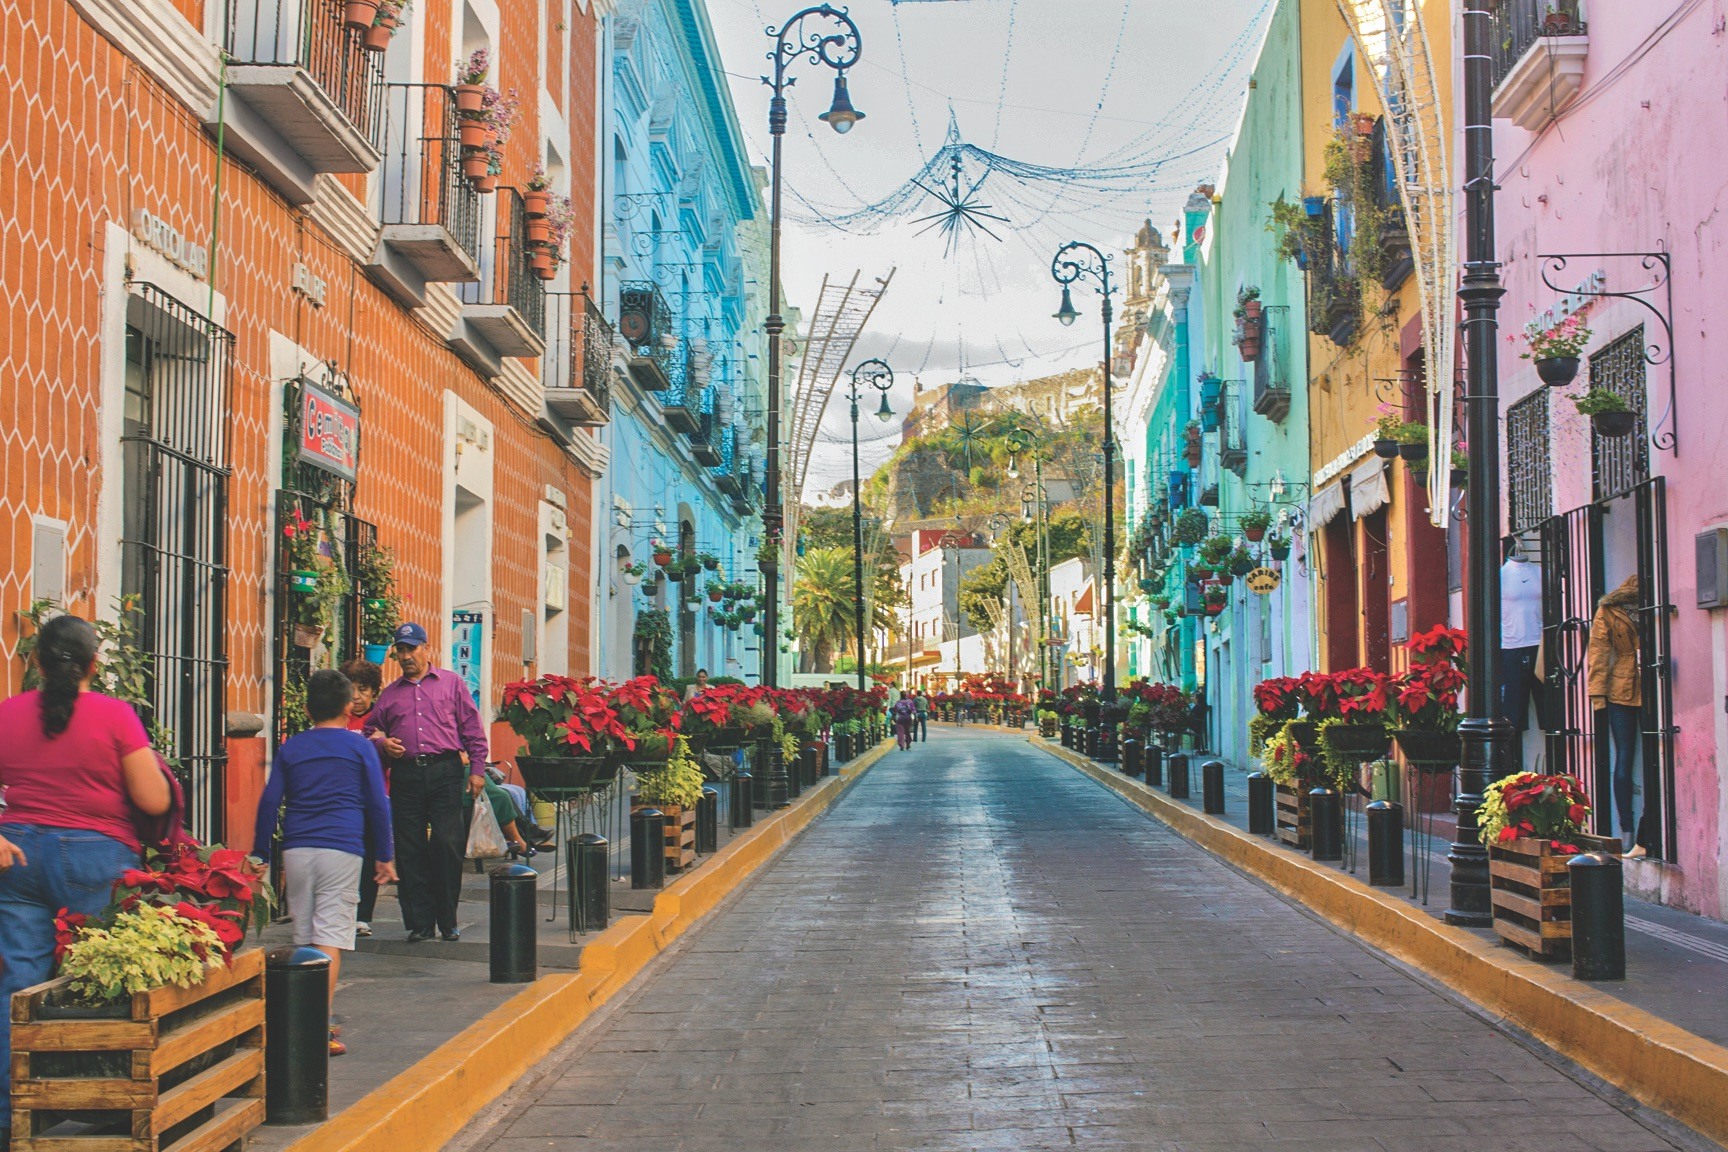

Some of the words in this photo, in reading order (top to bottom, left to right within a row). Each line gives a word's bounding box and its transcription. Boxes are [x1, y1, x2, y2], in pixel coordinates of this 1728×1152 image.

[138, 207, 209, 278] ORTOLAB
[1247, 569, 1280, 583] CARIBE
[459, 628, 470, 684] INT
